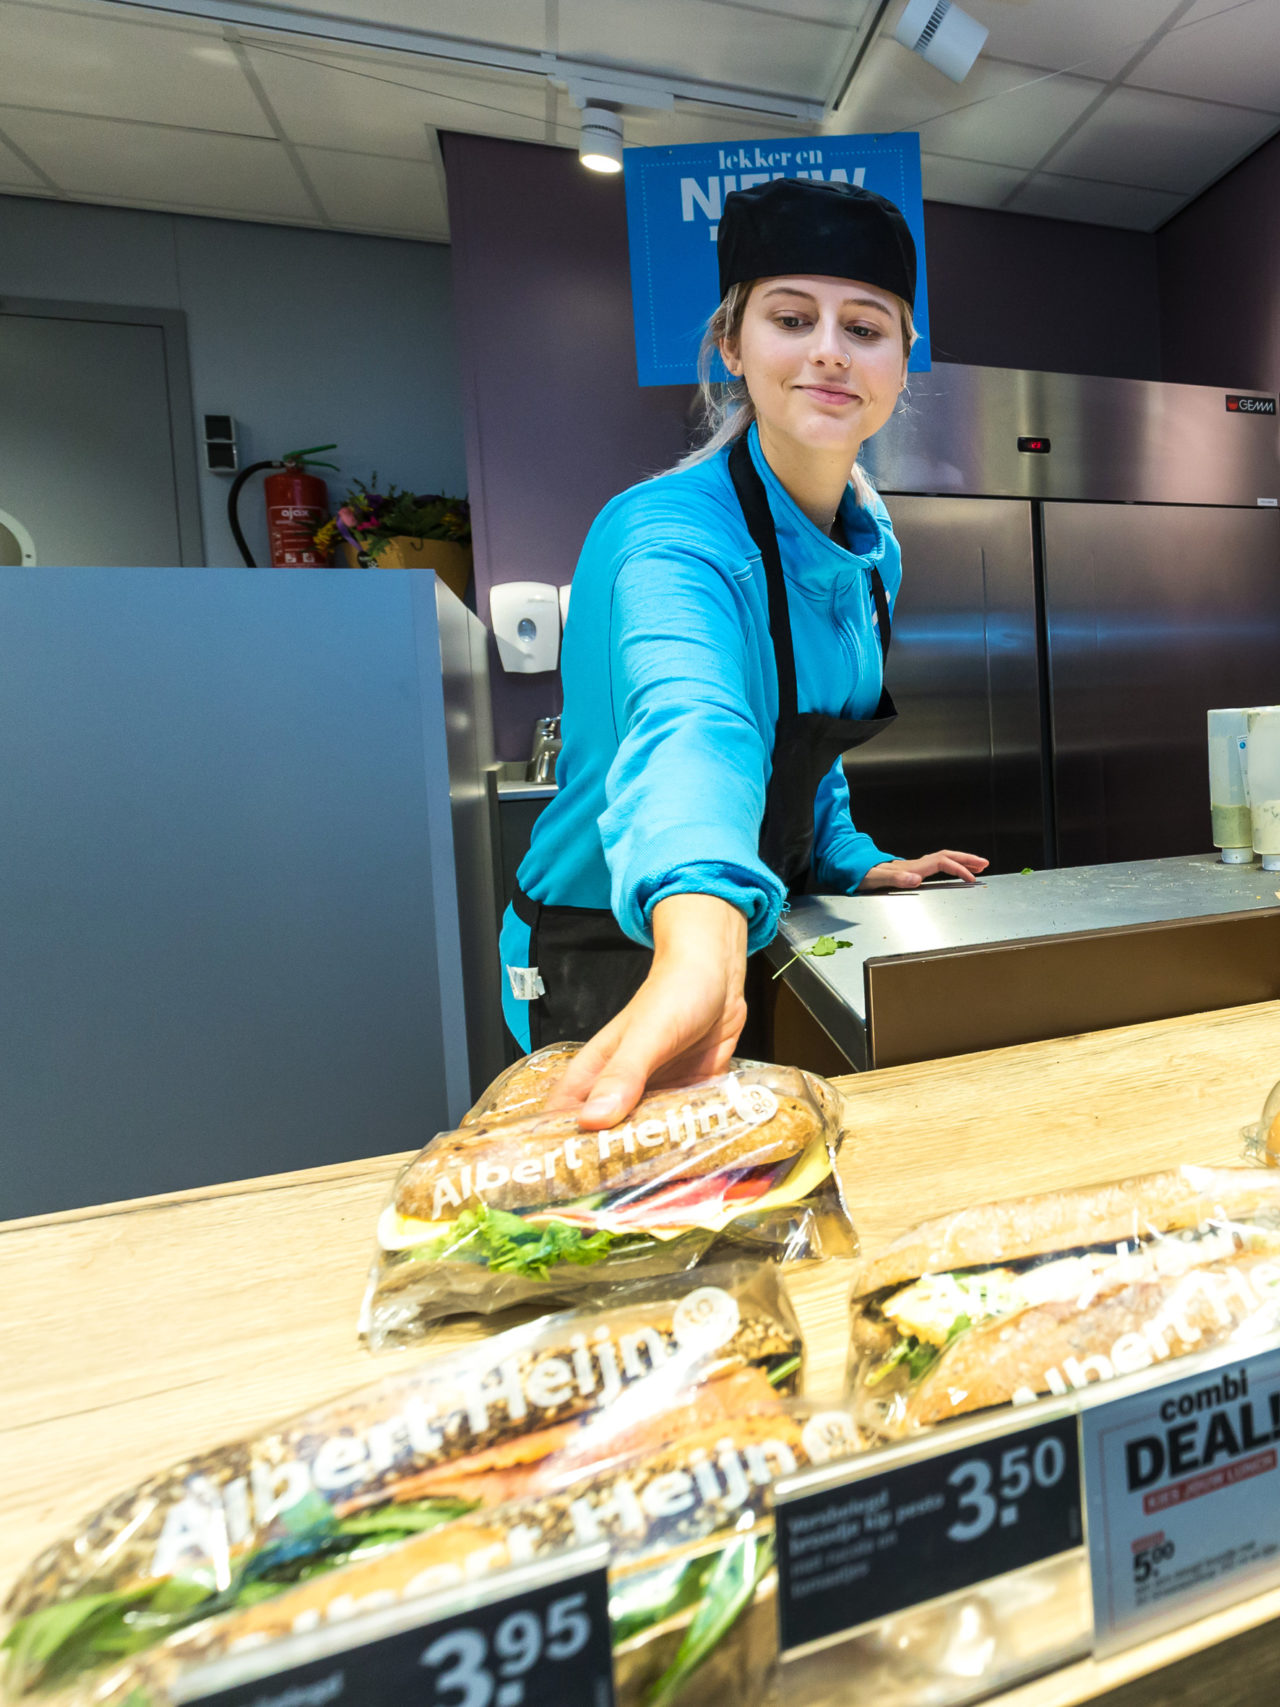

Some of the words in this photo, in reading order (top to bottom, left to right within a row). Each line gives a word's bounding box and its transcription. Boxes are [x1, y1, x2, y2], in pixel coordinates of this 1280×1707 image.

[718, 148, 791, 170] lekker
[796, 149, 823, 165] en
[1238, 399, 1274, 413] GEMM
[431, 1141, 582, 1222] Albert
[597, 1102, 731, 1160] Heijn
[1159, 1368, 1249, 1422] combi
[150, 1395, 445, 1590] Albert
[462, 1326, 668, 1436] Heijn
[947, 1436, 1066, 1542] 3.50
[1133, 1540, 1176, 1584] 5.00
